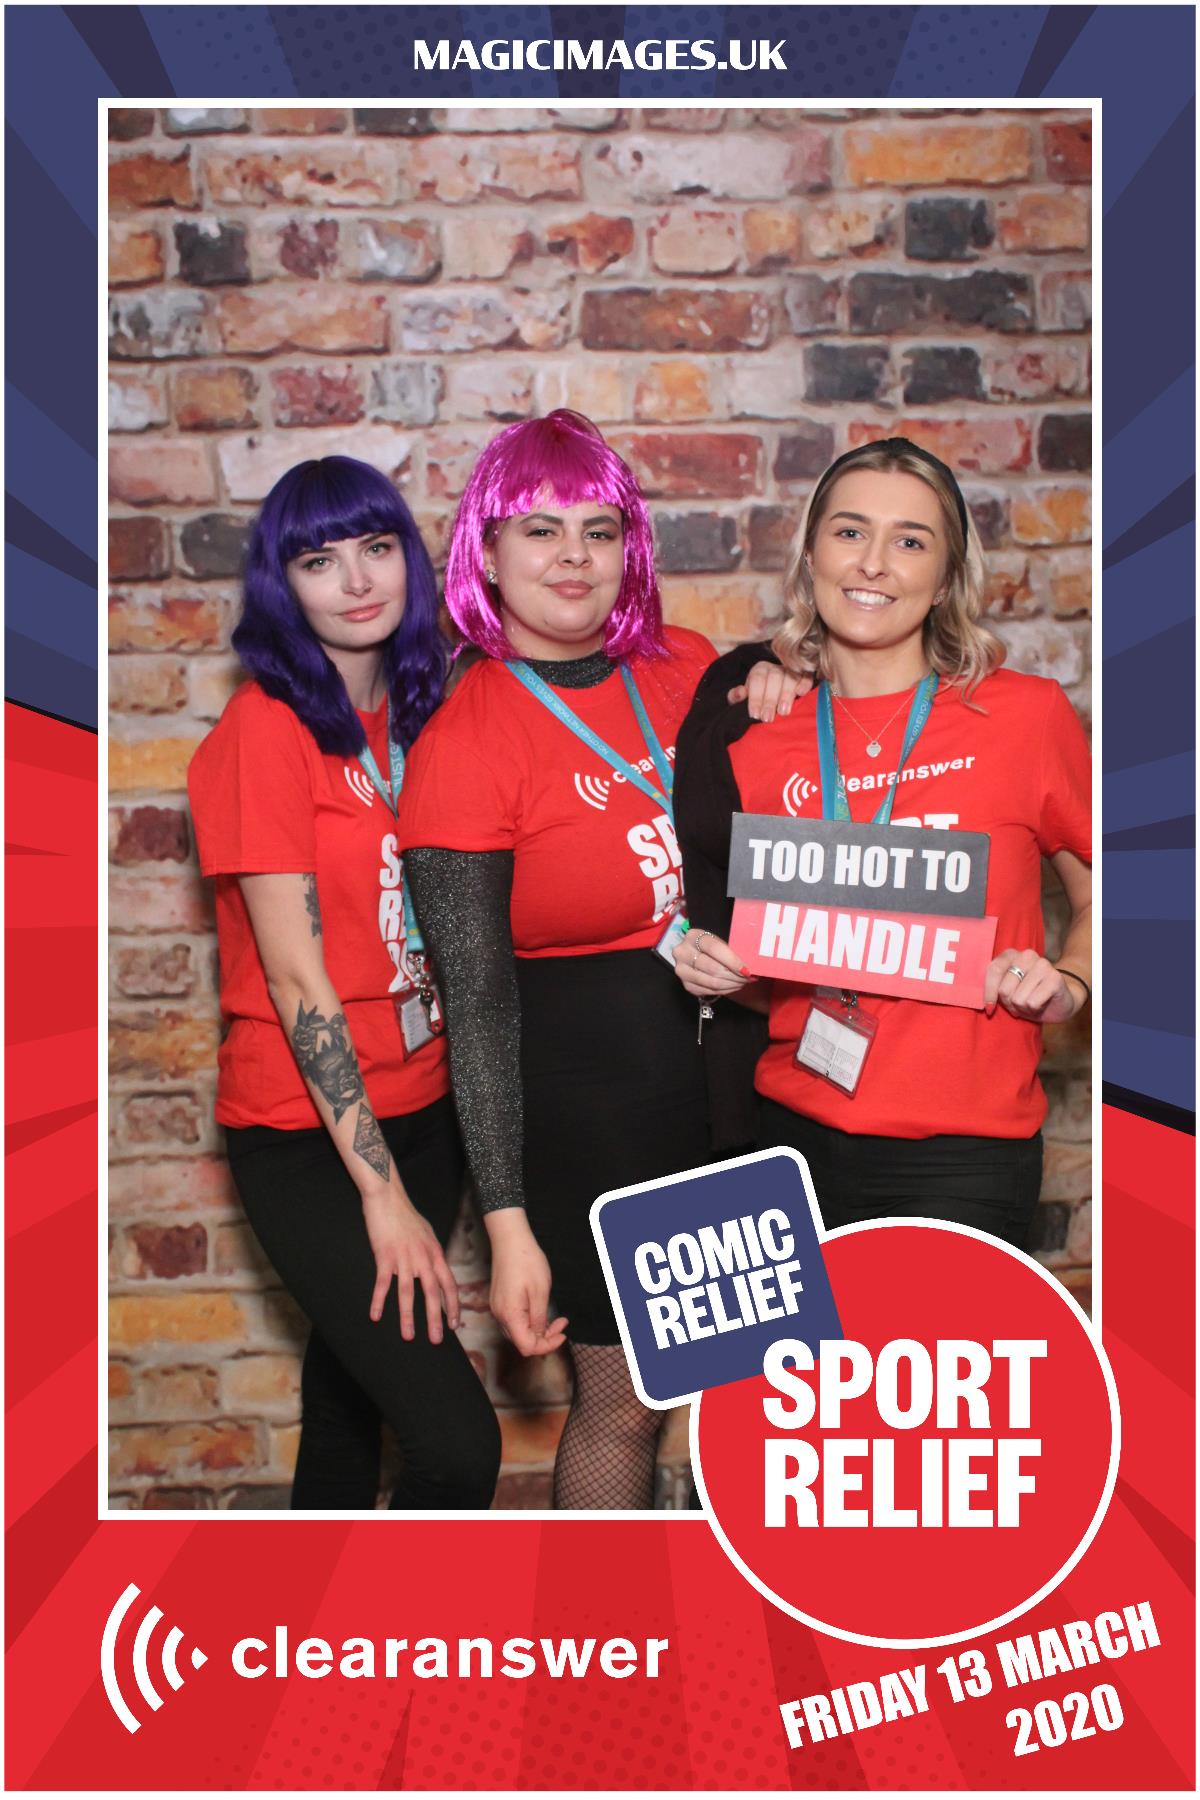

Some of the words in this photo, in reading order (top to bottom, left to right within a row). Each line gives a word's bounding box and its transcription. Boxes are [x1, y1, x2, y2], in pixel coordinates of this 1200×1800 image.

[748, 838, 825, 884] TOO
[834, 844, 915, 890] HOT
[921, 849, 972, 894] TO
[759, 902, 962, 985] HANDLE
